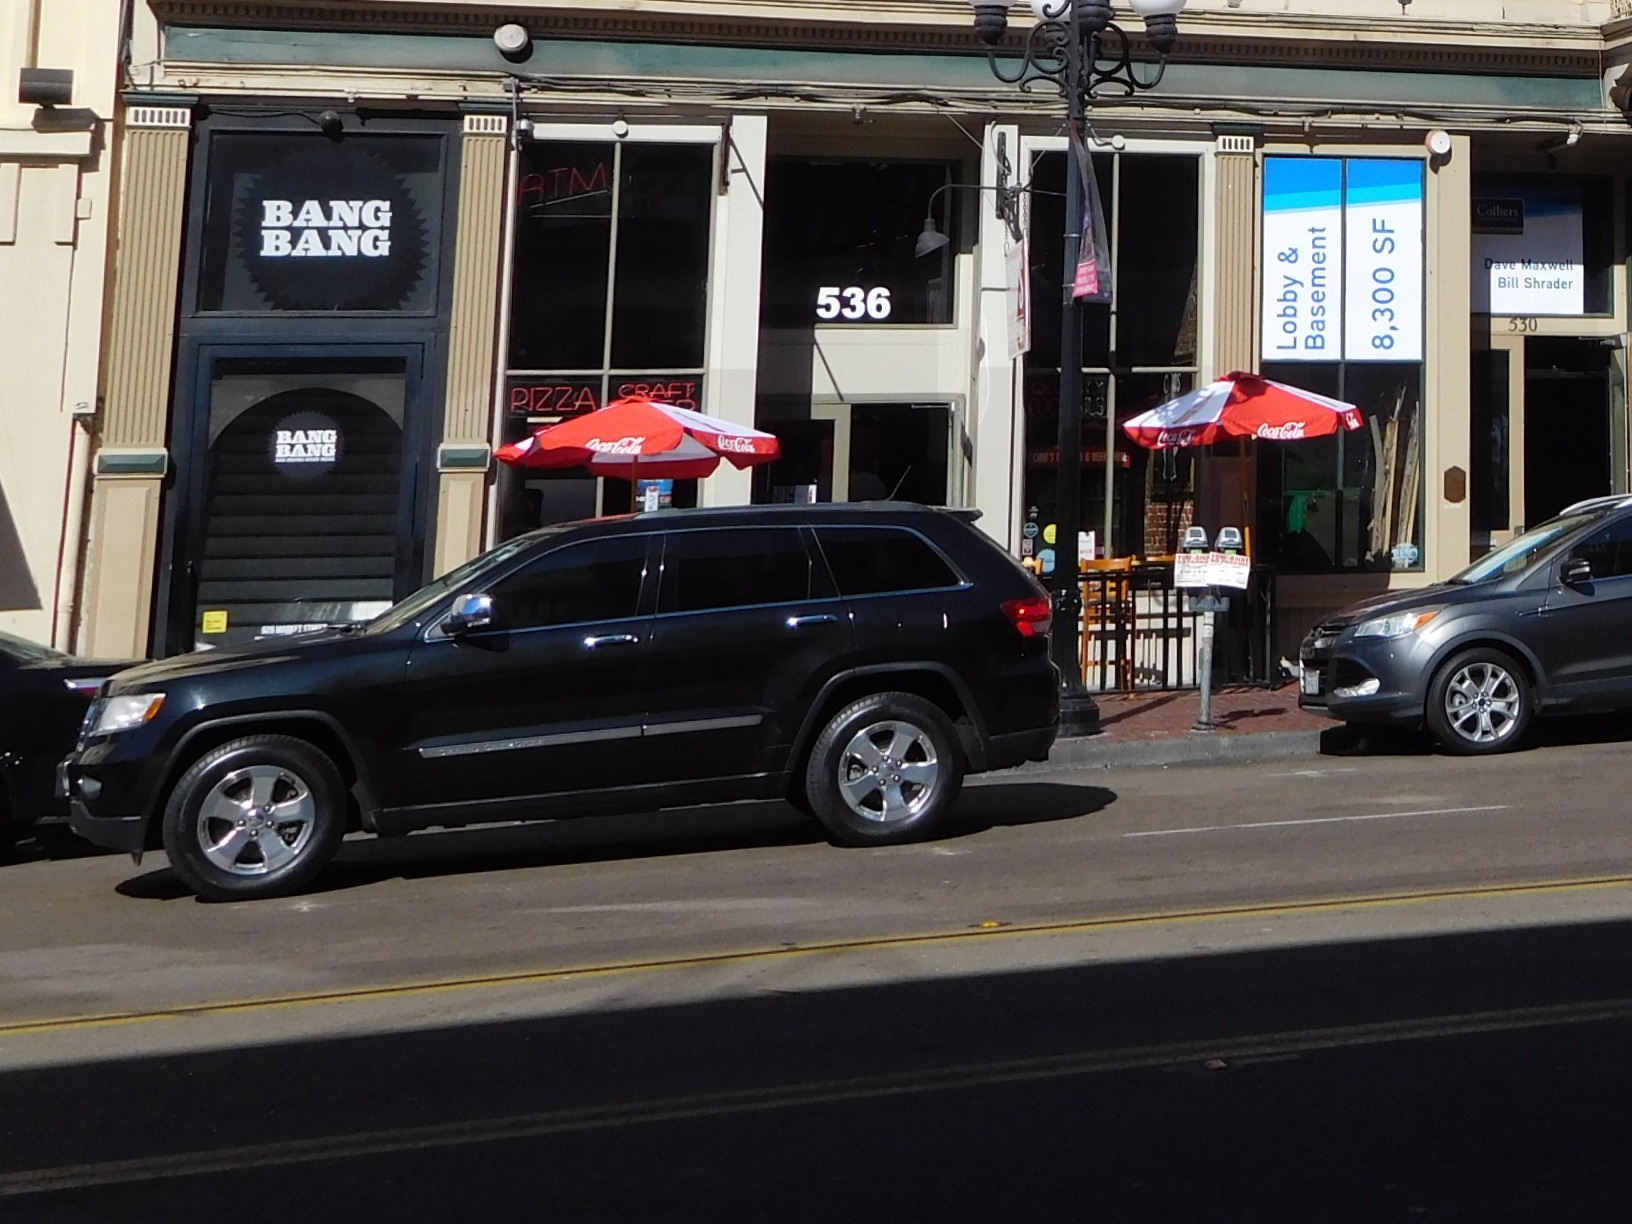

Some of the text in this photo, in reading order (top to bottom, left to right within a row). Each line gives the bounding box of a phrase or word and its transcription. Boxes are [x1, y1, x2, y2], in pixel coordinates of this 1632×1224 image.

[515, 162, 608, 208] ATM
[261, 199, 393, 227] BANG
[1477, 203, 1519, 217] Colliers
[259, 228, 392, 257] BANG
[1484, 258, 1573, 271] Dave Maxwell
[1304, 226, 1327, 350] Basement
[1371, 218, 1399, 350] 8,300 SF
[1497, 277, 1574, 290] Bill Shrader
[816, 286, 892, 319] 536
[1276, 247, 1304, 350] Lobby &
[1508, 316, 1538, 332] 530
[510, 387, 597, 411] PIZZA
[618, 382, 696, 398] CRAFT
[276, 430, 338, 444] BANG
[275, 444, 337, 458] BANG
